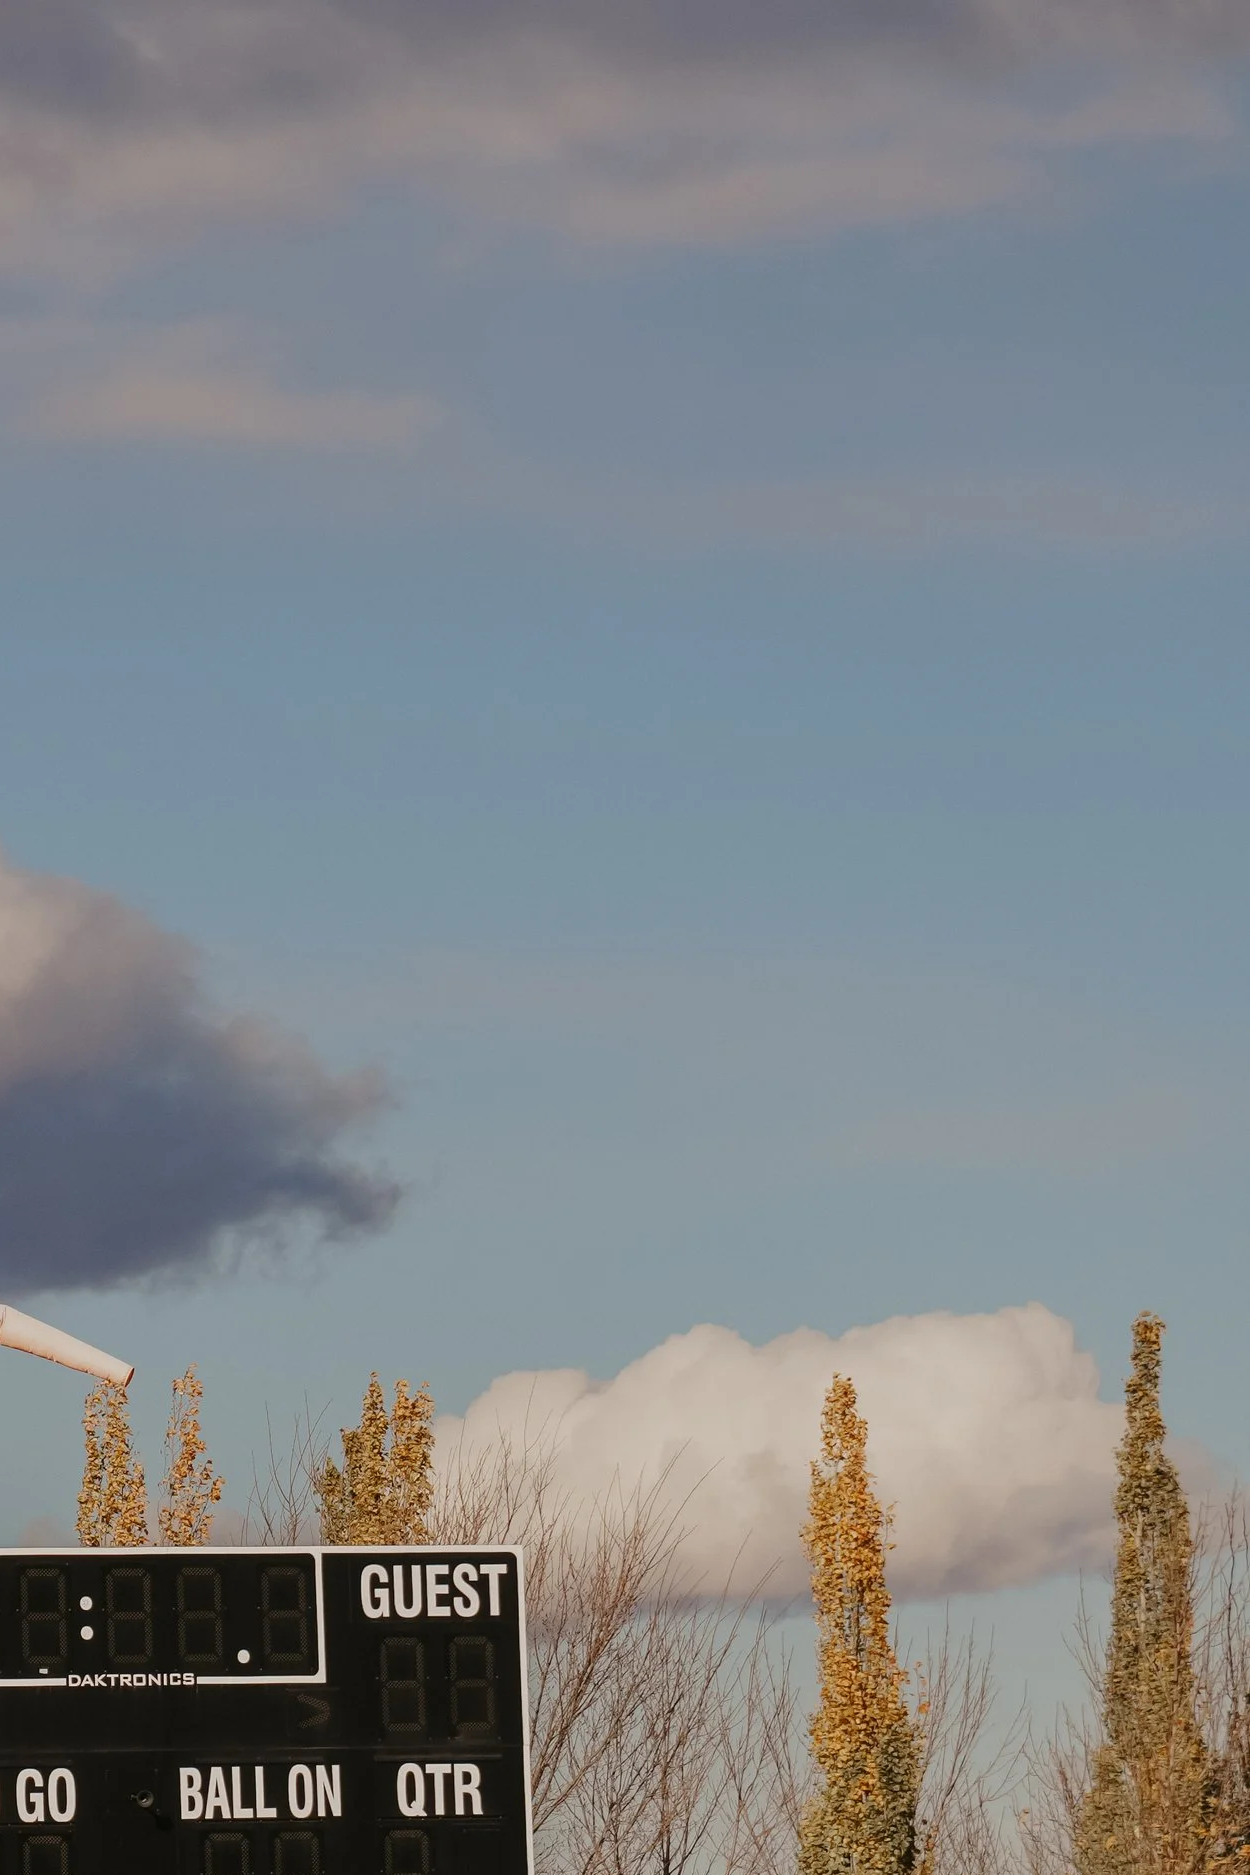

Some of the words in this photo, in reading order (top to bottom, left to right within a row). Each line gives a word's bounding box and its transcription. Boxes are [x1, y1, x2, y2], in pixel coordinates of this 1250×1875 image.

[360, 1562, 508, 1619] GUEST
[68, 1672, 195, 1687] DAKTRONICS
[15, 1767, 77, 1823] GO
[179, 1765, 278, 1820] BALL
[287, 1763, 342, 1819] ON
[396, 1762, 484, 1817] QTR
